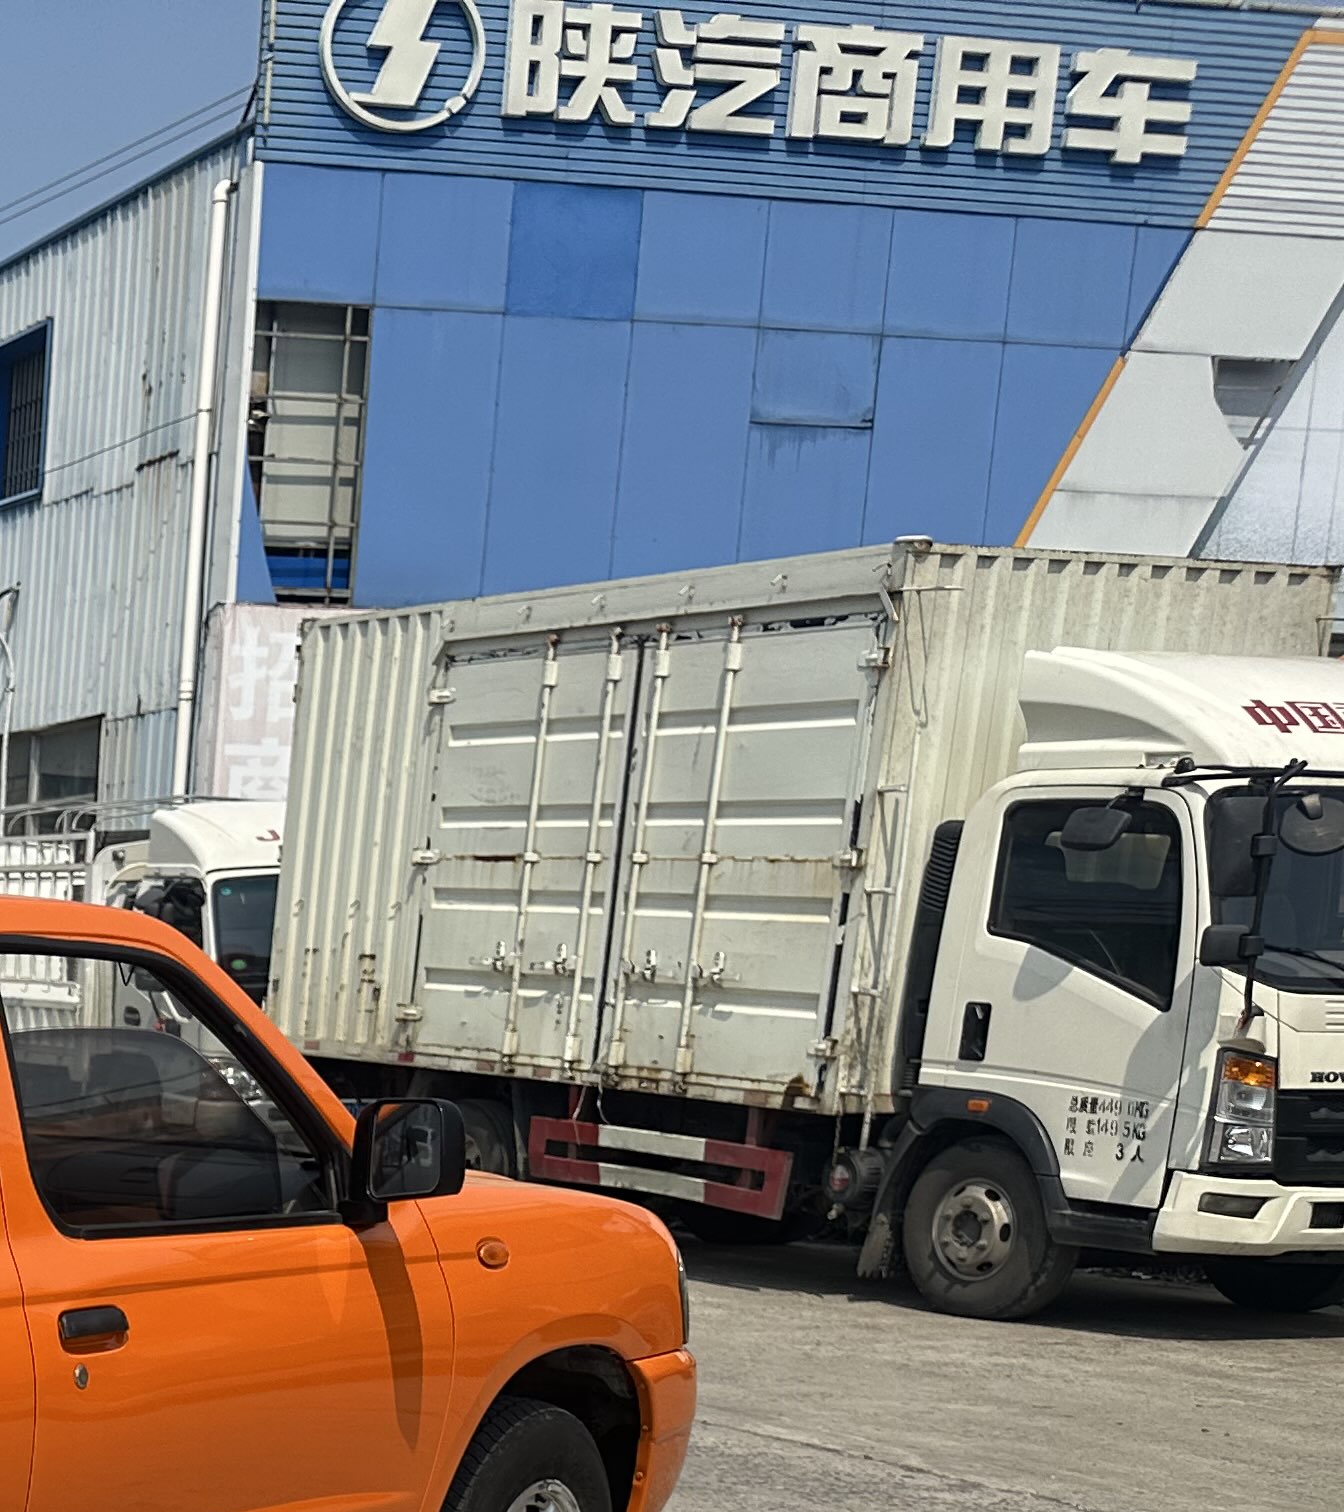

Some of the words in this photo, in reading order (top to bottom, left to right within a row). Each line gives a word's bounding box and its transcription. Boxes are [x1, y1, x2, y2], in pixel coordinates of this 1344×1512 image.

[500, 1, 1200, 165] 陕汽商用车
